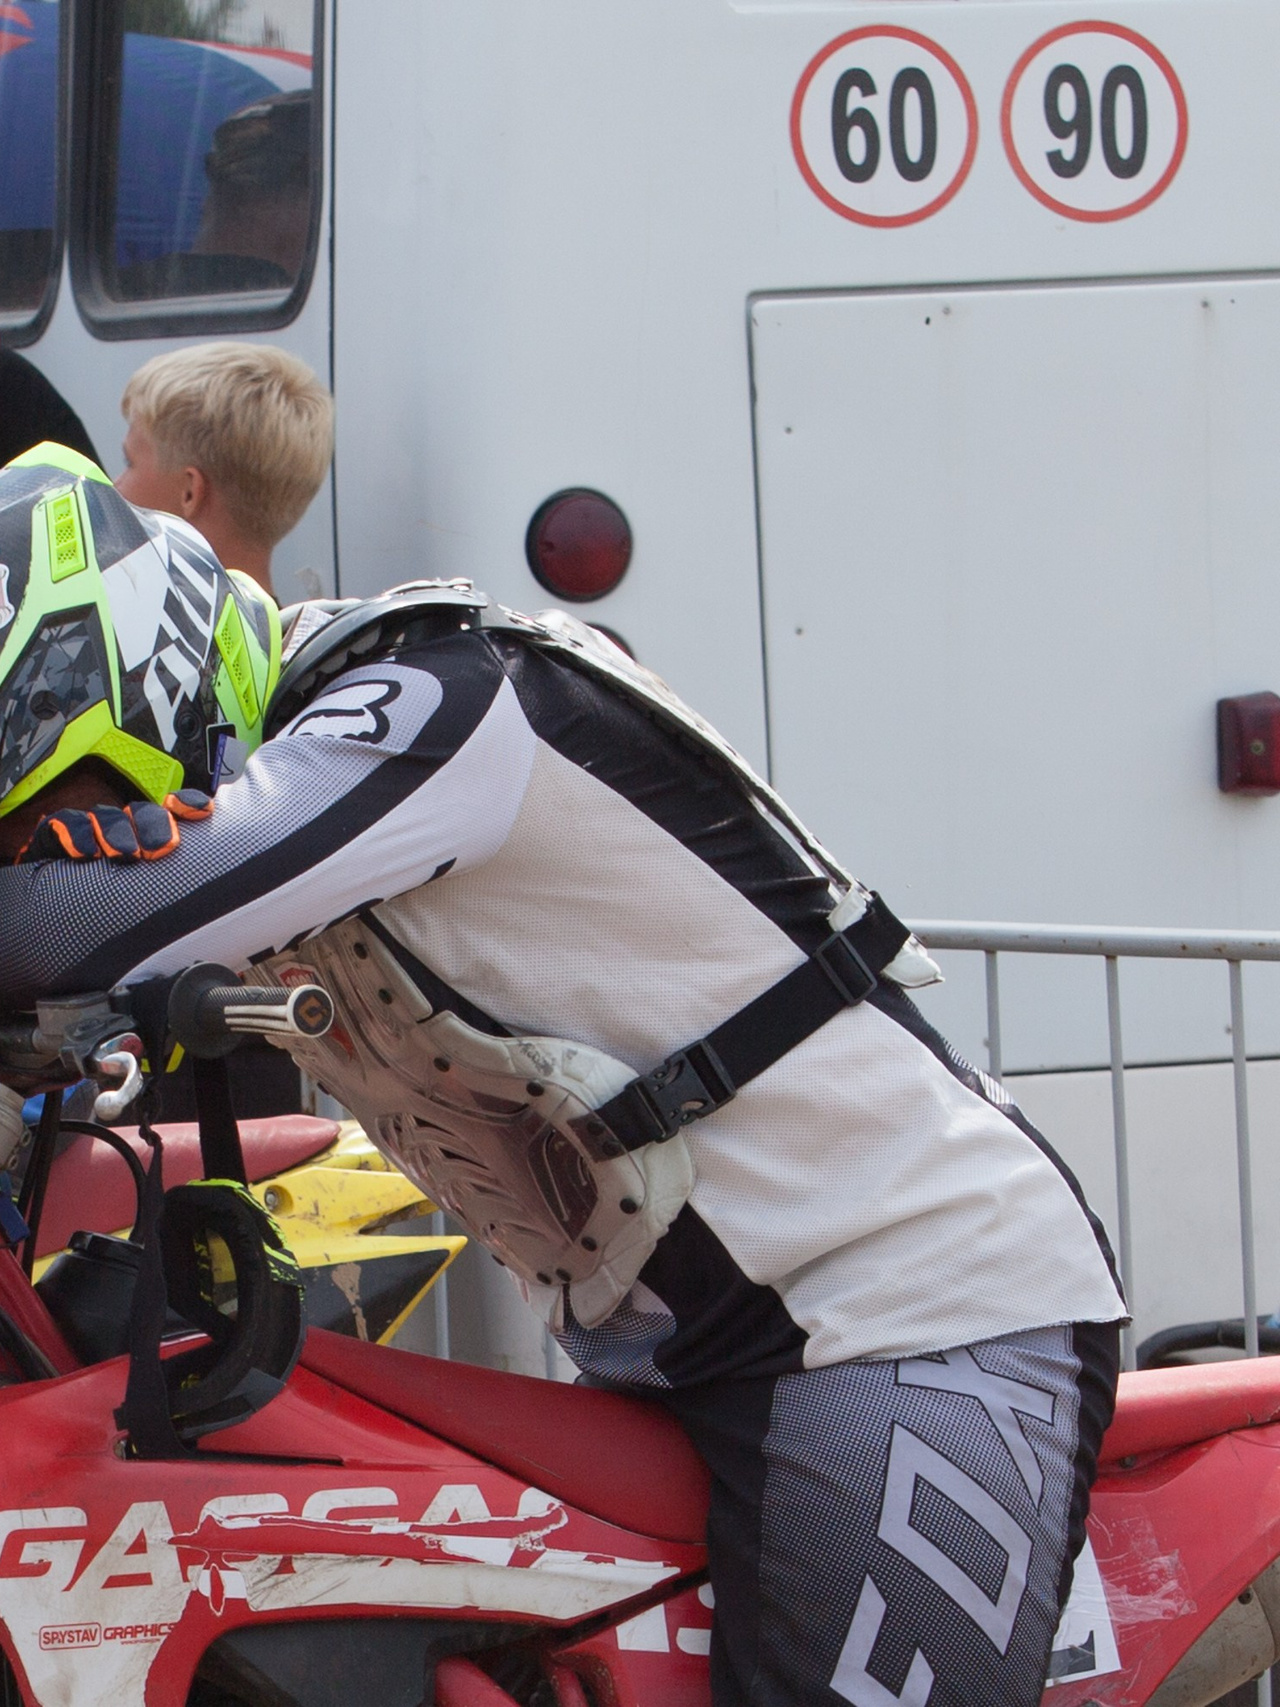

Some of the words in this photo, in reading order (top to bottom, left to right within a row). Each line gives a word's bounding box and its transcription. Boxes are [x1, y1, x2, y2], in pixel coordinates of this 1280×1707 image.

[831, 67, 937, 183] 60
[1042, 64, 1148, 179] 90
[829, 1346, 1058, 1707] FOX
